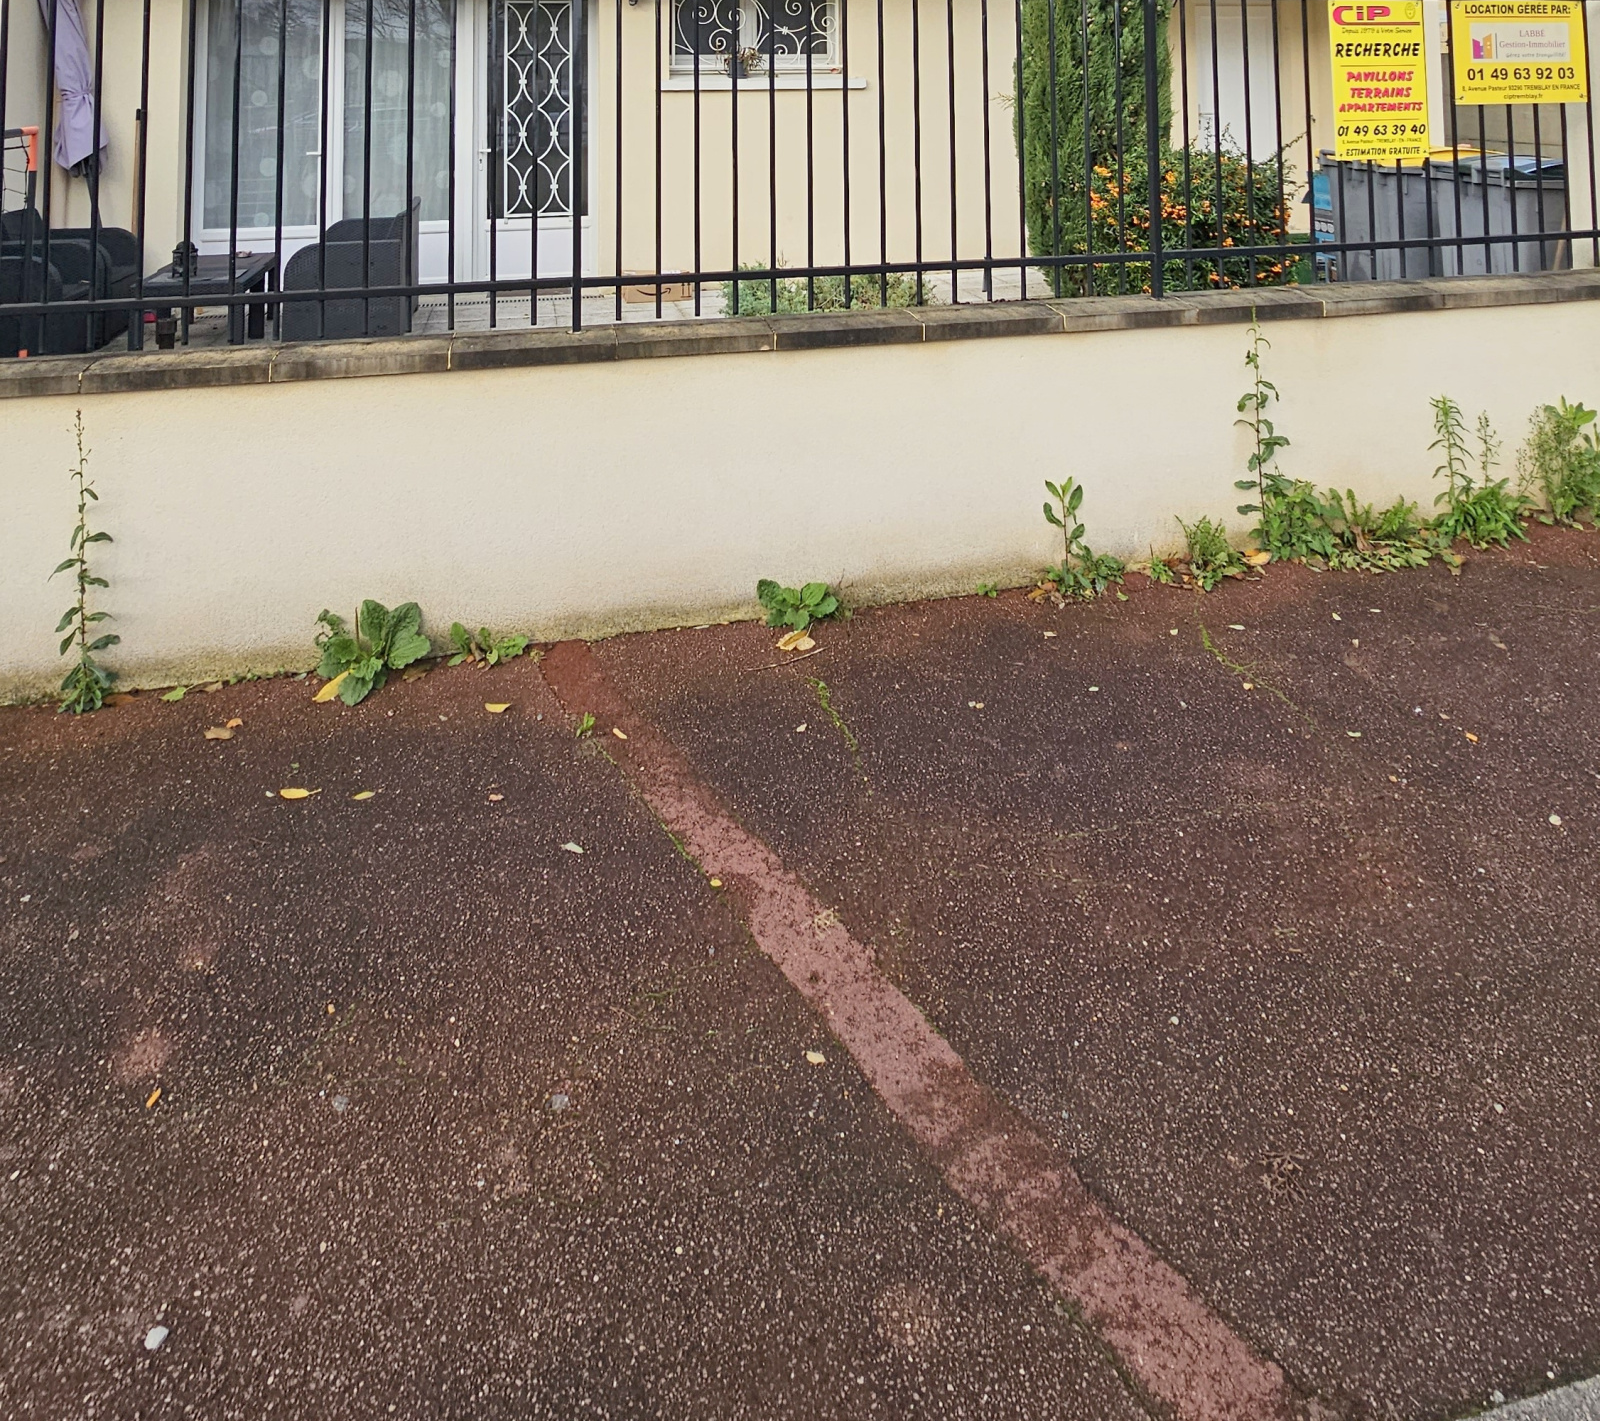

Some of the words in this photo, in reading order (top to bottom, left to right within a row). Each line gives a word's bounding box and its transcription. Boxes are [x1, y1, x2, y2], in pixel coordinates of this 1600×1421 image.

[1464, 4, 1514, 14] LOCATION
[1517, 2, 1548, 14] GÉRÉE
[1551, 4, 1571, 14] PAR:
[1335, 42, 1420, 58] RECHERCHE
[1499, 40, 1566, 48] Gestion-Immobilier
[1346, 70, 1414, 82] PAVILLONS
[1467, 68, 1484, 80] 01
[1490, 68, 1508, 80] 49
[1513, 67, 1531, 80] 63
[1535, 67, 1553, 80] 92
[1557, 67, 1575, 79] 03
[1350, 87, 1412, 99] TERRAINS
[1339, 102, 1423, 113] APPARTEMENTS
[1337, 125, 1349, 137] 01
[1353, 125, 1369, 137] 49
[1373, 124, 1387, 136] 63
[1391, 124, 1406, 136] 39
[1410, 123, 1426, 135] 40
[1346, 148, 1386, 157] ESTIMATION
[1388, 146, 1420, 155] GRATUITE
